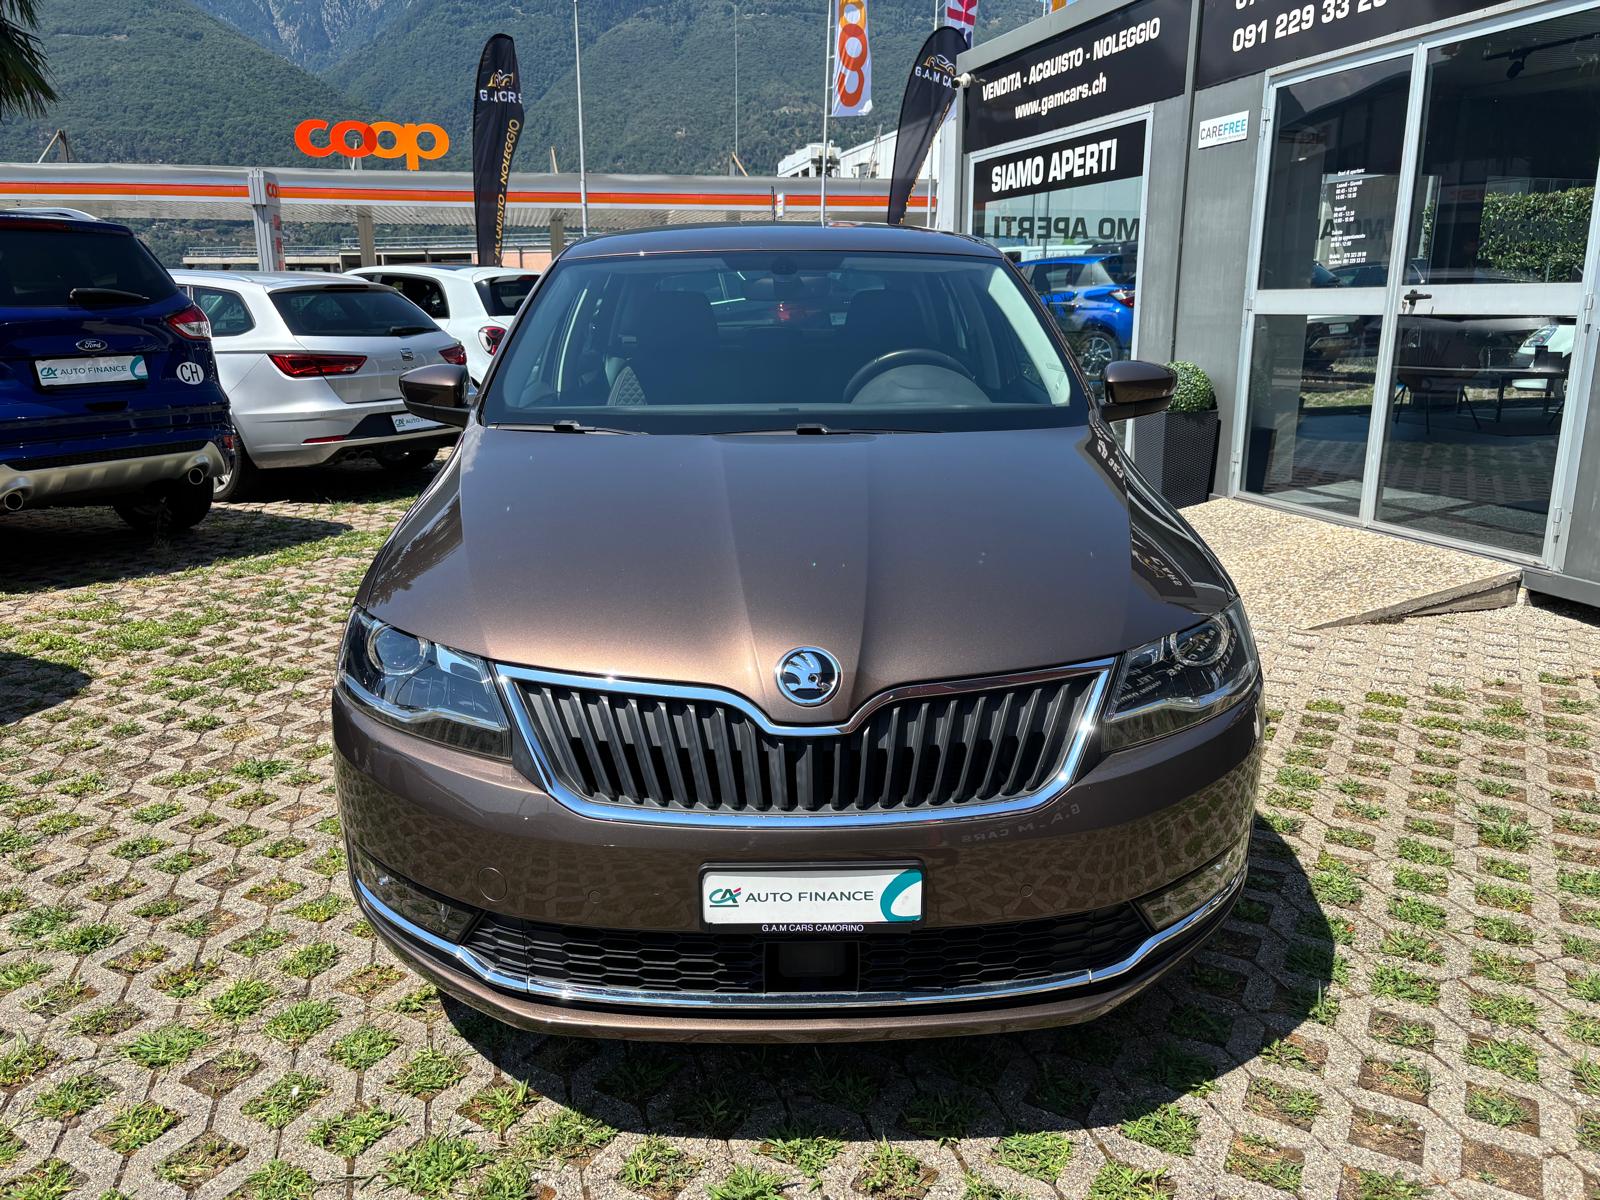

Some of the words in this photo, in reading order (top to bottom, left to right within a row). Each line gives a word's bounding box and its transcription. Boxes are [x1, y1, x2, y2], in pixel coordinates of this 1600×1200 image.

[1232, 19, 1268, 52] 091
[1274, 4, 1315, 40] 229
[1321, 0, 1350, 24] 33
[982, 71, 1022, 101] VENDITA
[1028, 47, 1084, 86] ACQUISTO
[1092, 17, 1161, 62] NOLEGGIO
[1015, 72, 1107, 120] www.gamcars.ch
[294, 118, 450, 171] coop
[1200, 119, 1247, 141] CAREFREE
[501, 119, 520, 185] NOLEGGIO
[991, 155, 1044, 193] SIAMO
[1048, 138, 1118, 183] APERTI
[84, 341, 101, 349] Ford
[60, 367, 86, 375] AUTO
[88, 365, 128, 373] FINANCE
[180, 364, 201, 383] CH
[745, 892, 793, 903] AUTO
[798, 890, 874, 902] FINANCE
[762, 924, 787, 932] G.A.M
[789, 924, 814, 932] CARS
[815, 924, 864, 932] CAMORINO
